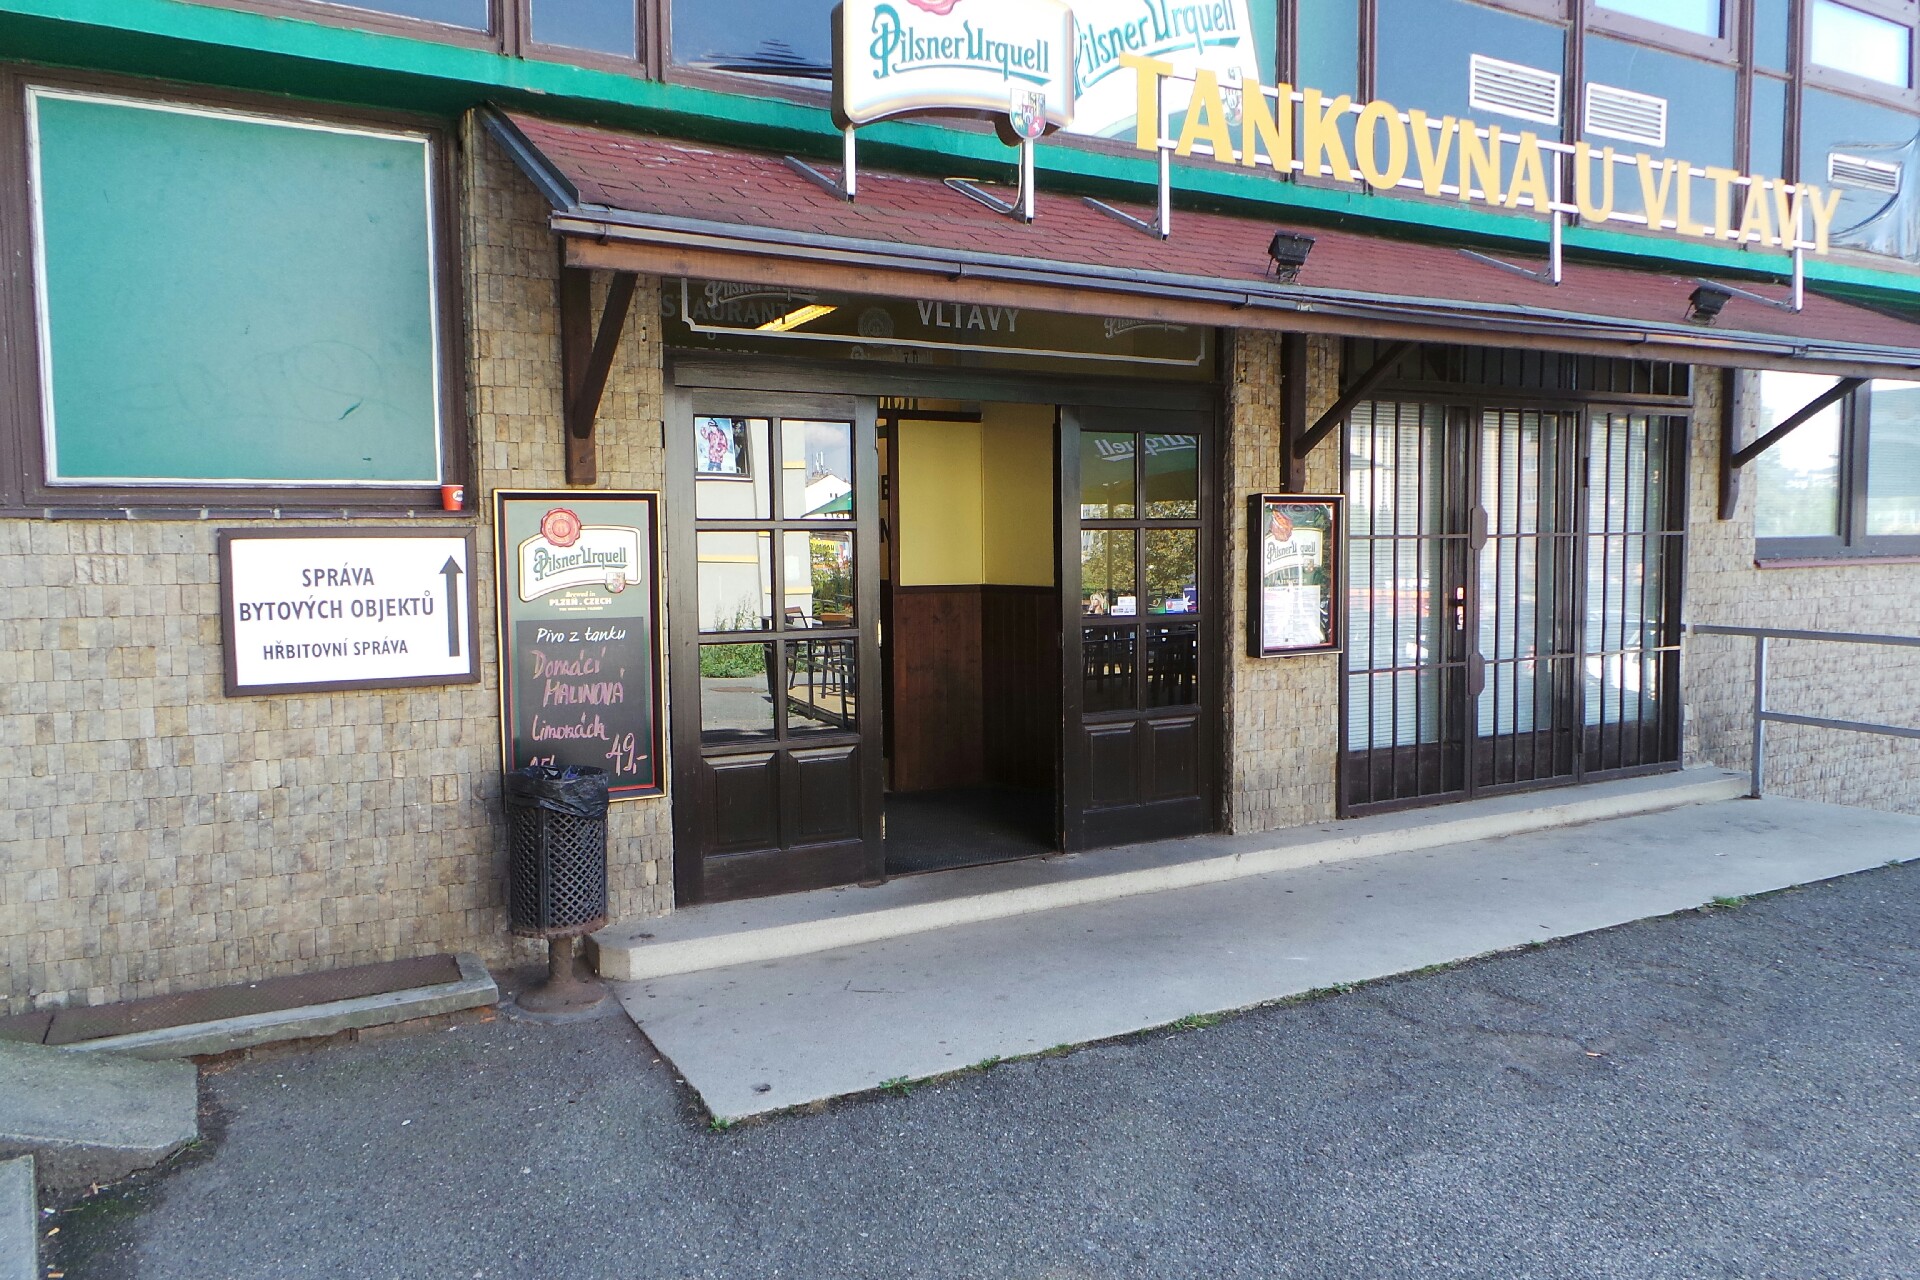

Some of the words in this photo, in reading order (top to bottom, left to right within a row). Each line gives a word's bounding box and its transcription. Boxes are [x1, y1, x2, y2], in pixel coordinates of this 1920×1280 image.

[870, 4, 968, 80] Pilsner
[964, 20, 1049, 81] Urquell
[1144, 0, 1237, 55] Urquell
[1119, 52, 1554, 212] TANKOVNA
[1575, 141, 1614, 223] U
[1636, 152, 1842, 256] VLTAVY
[917, 299, 1019, 332] VLTAVY
[533, 547, 582, 582] Pilsner
[579, 545, 627, 570] Urquell
[1267, 541, 1292, 565] Pilsner
[1291, 540, 1316, 558] Uquell
[302, 562, 375, 588] SPRÁVA
[239, 595, 343, 621] BYTOVÝCH
[350, 590, 434, 622] OBJEKTŮ
[263, 637, 348, 660] HŘBITOVNÍ
[353, 636, 409, 656] SPRÁVA
[537, 627, 565, 643] Pivo
[568, 631, 580, 642] z
[585, 625, 627, 643] tanku
[530, 646, 606, 680] Domácí
[542, 667, 626, 708] MALINOVÁ
